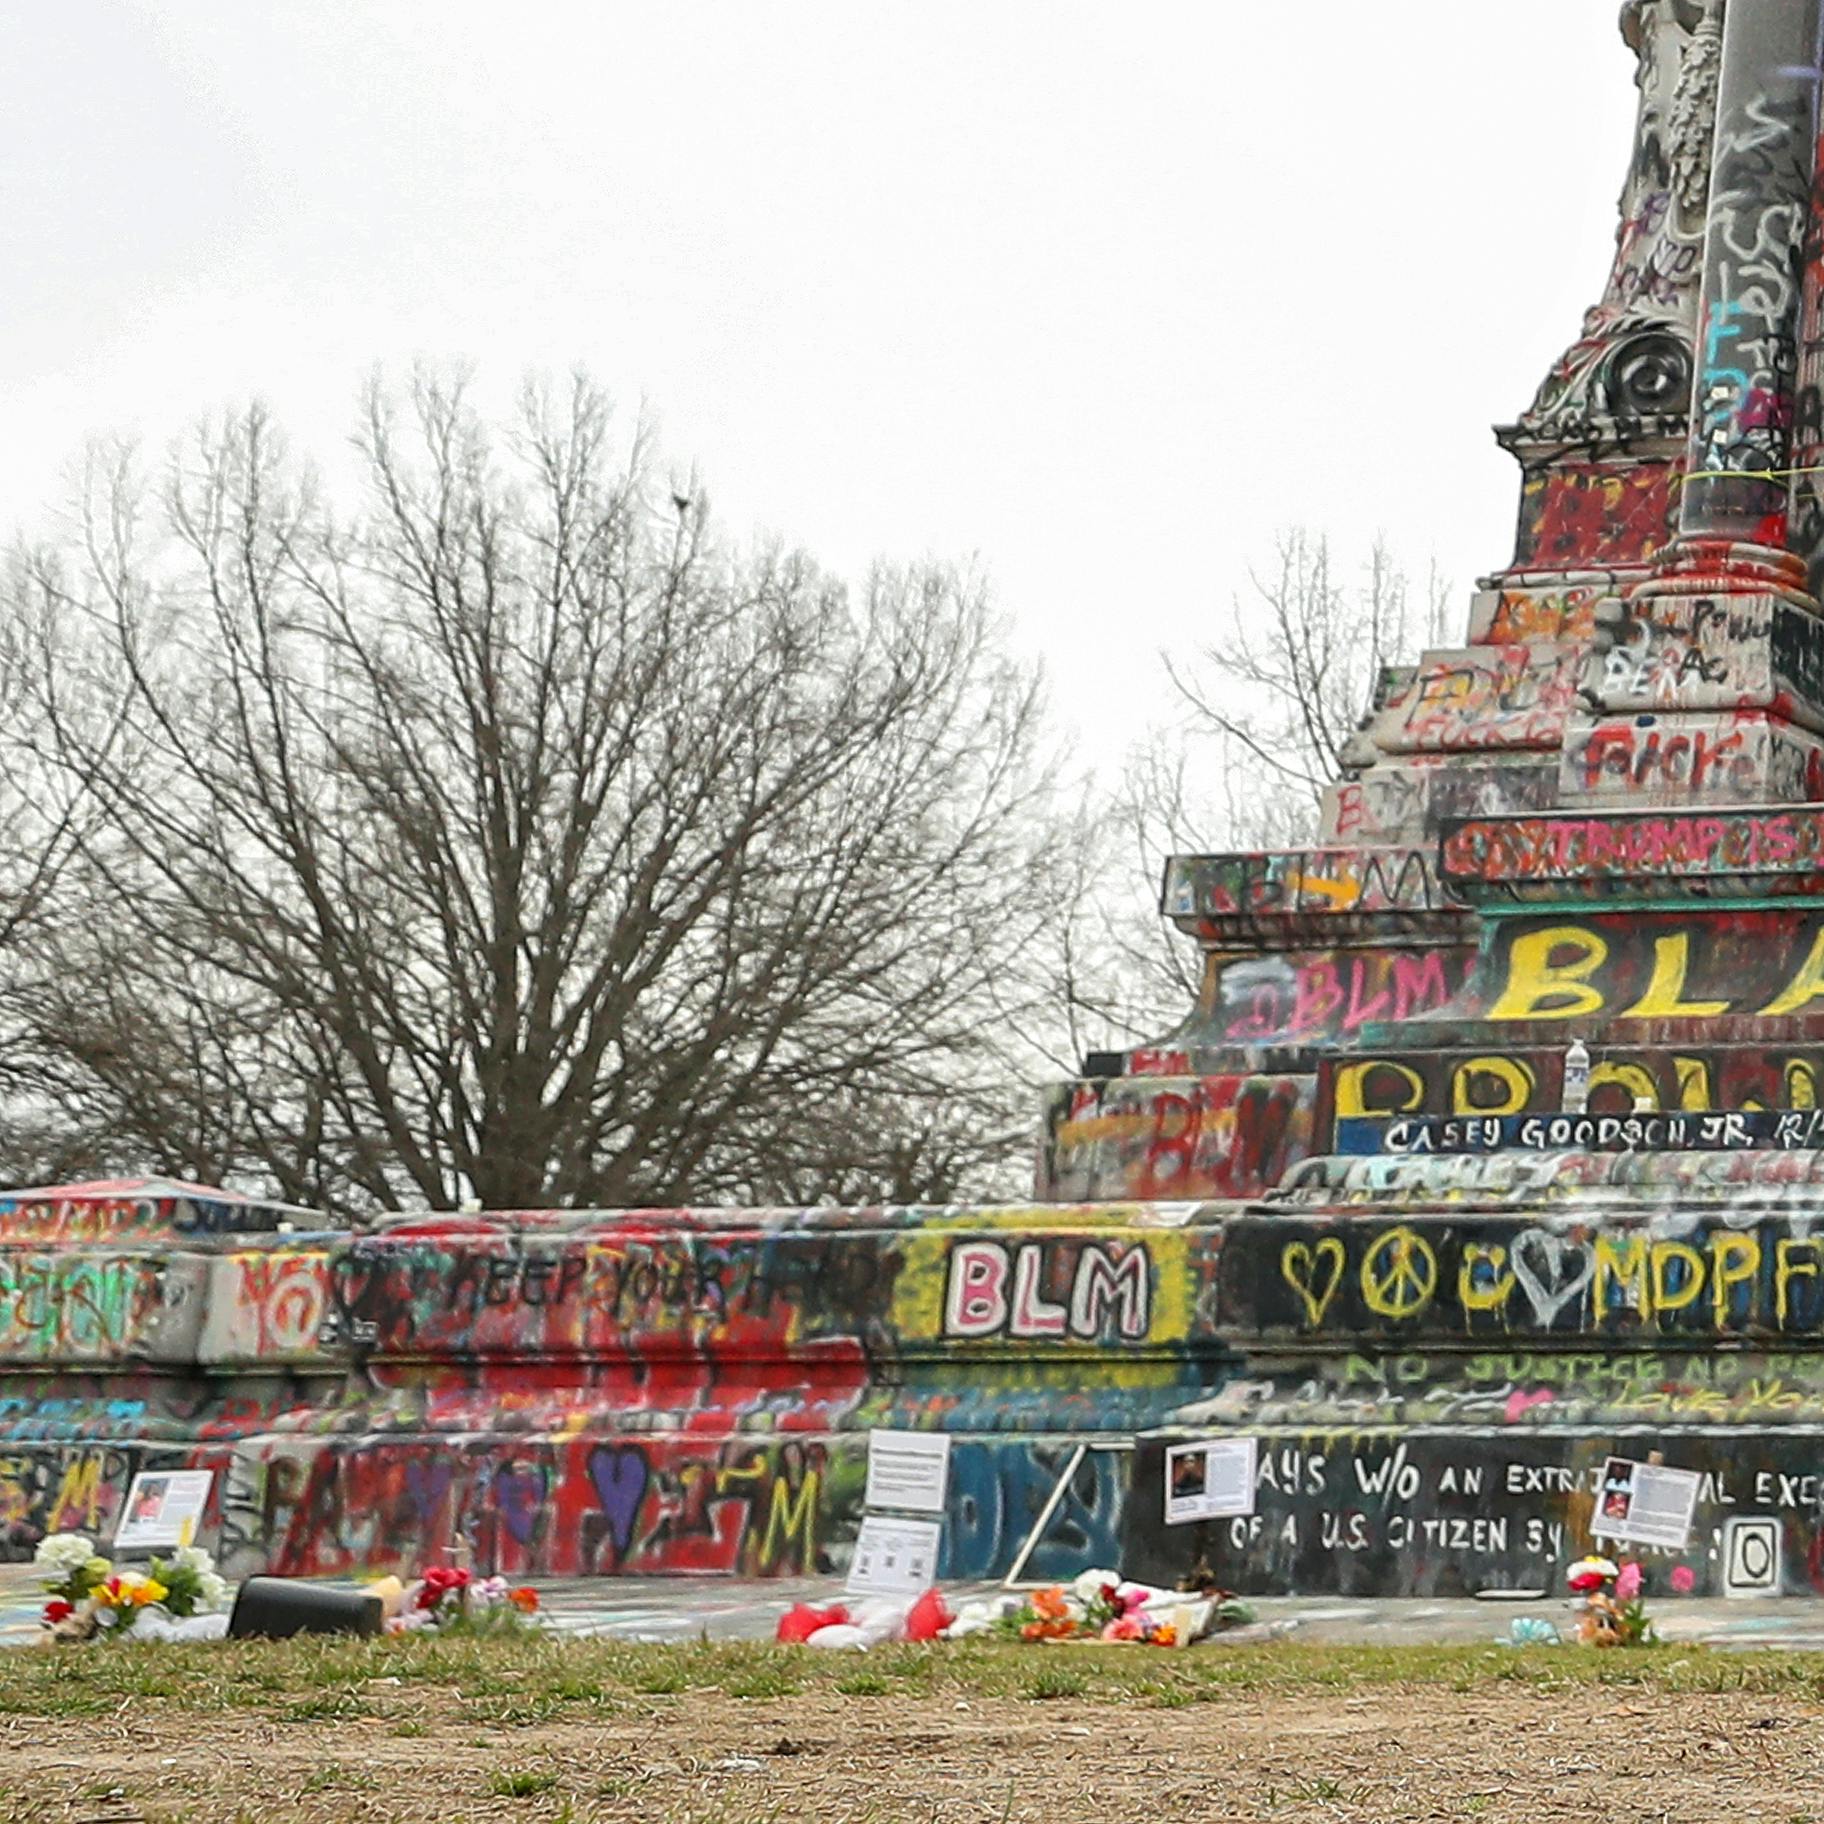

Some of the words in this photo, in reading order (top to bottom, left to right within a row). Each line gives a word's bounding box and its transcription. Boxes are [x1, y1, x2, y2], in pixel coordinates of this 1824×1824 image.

[1546, 817, 1725, 867] TRUMP
[1384, 1115, 1501, 1152] CASEY
[943, 1233, 1153, 1344] BLM
[1256, 1449, 1327, 1497] AYS
[1353, 1442, 1421, 1512] W/O
[1437, 1465, 1483, 1495] AN
[1229, 1515, 1264, 1550] OF
[1280, 1514, 1298, 1547] A
[1388, 1516, 1510, 1553] CITIZEN
